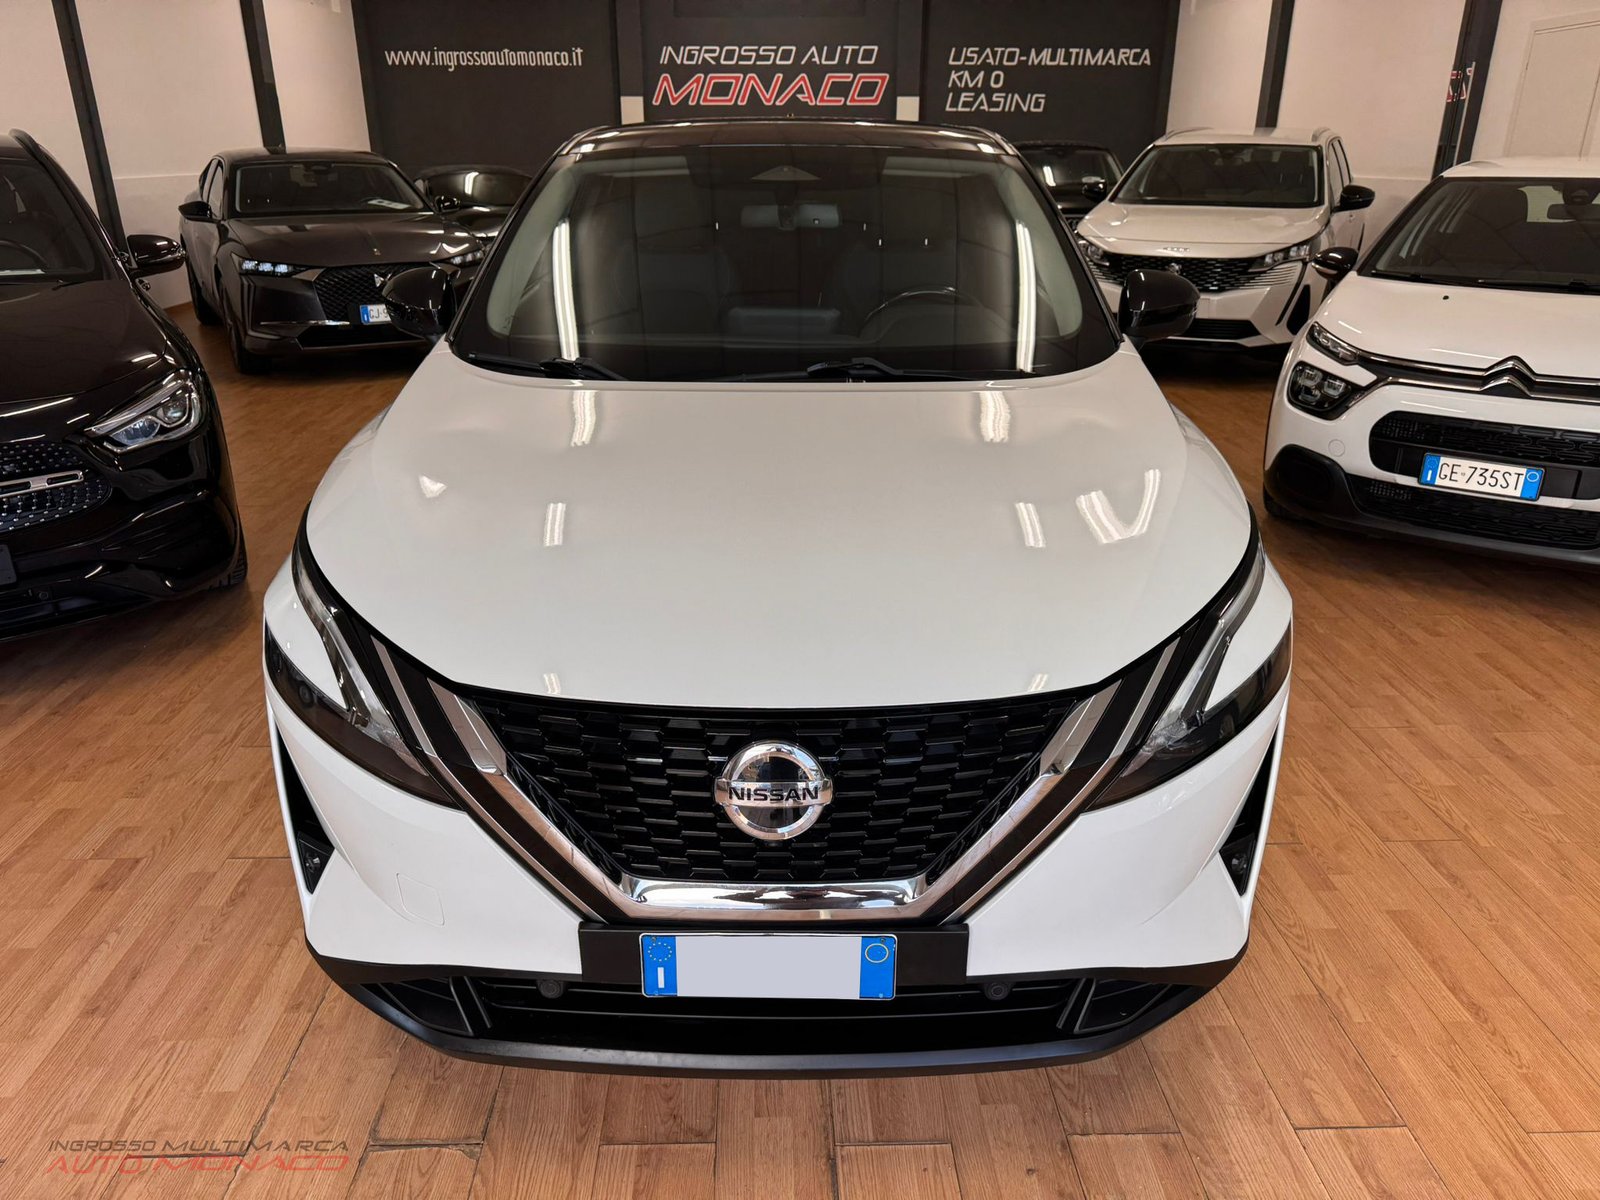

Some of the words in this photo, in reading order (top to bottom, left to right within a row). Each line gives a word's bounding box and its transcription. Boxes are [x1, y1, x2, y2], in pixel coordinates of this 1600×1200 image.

[385, 47, 584, 72] www.ingrossoautomonaco.it
[659, 45, 796, 65] INGROSSO
[801, 45, 878, 65] AUTO
[948, 47, 1151, 66] USATO-MULTIMARCA
[948, 70, 985, 88] KM
[652, 73, 890, 106] MONACO
[945, 92, 1046, 112] LEASING
[728, 786, 818, 801] NISSAN
